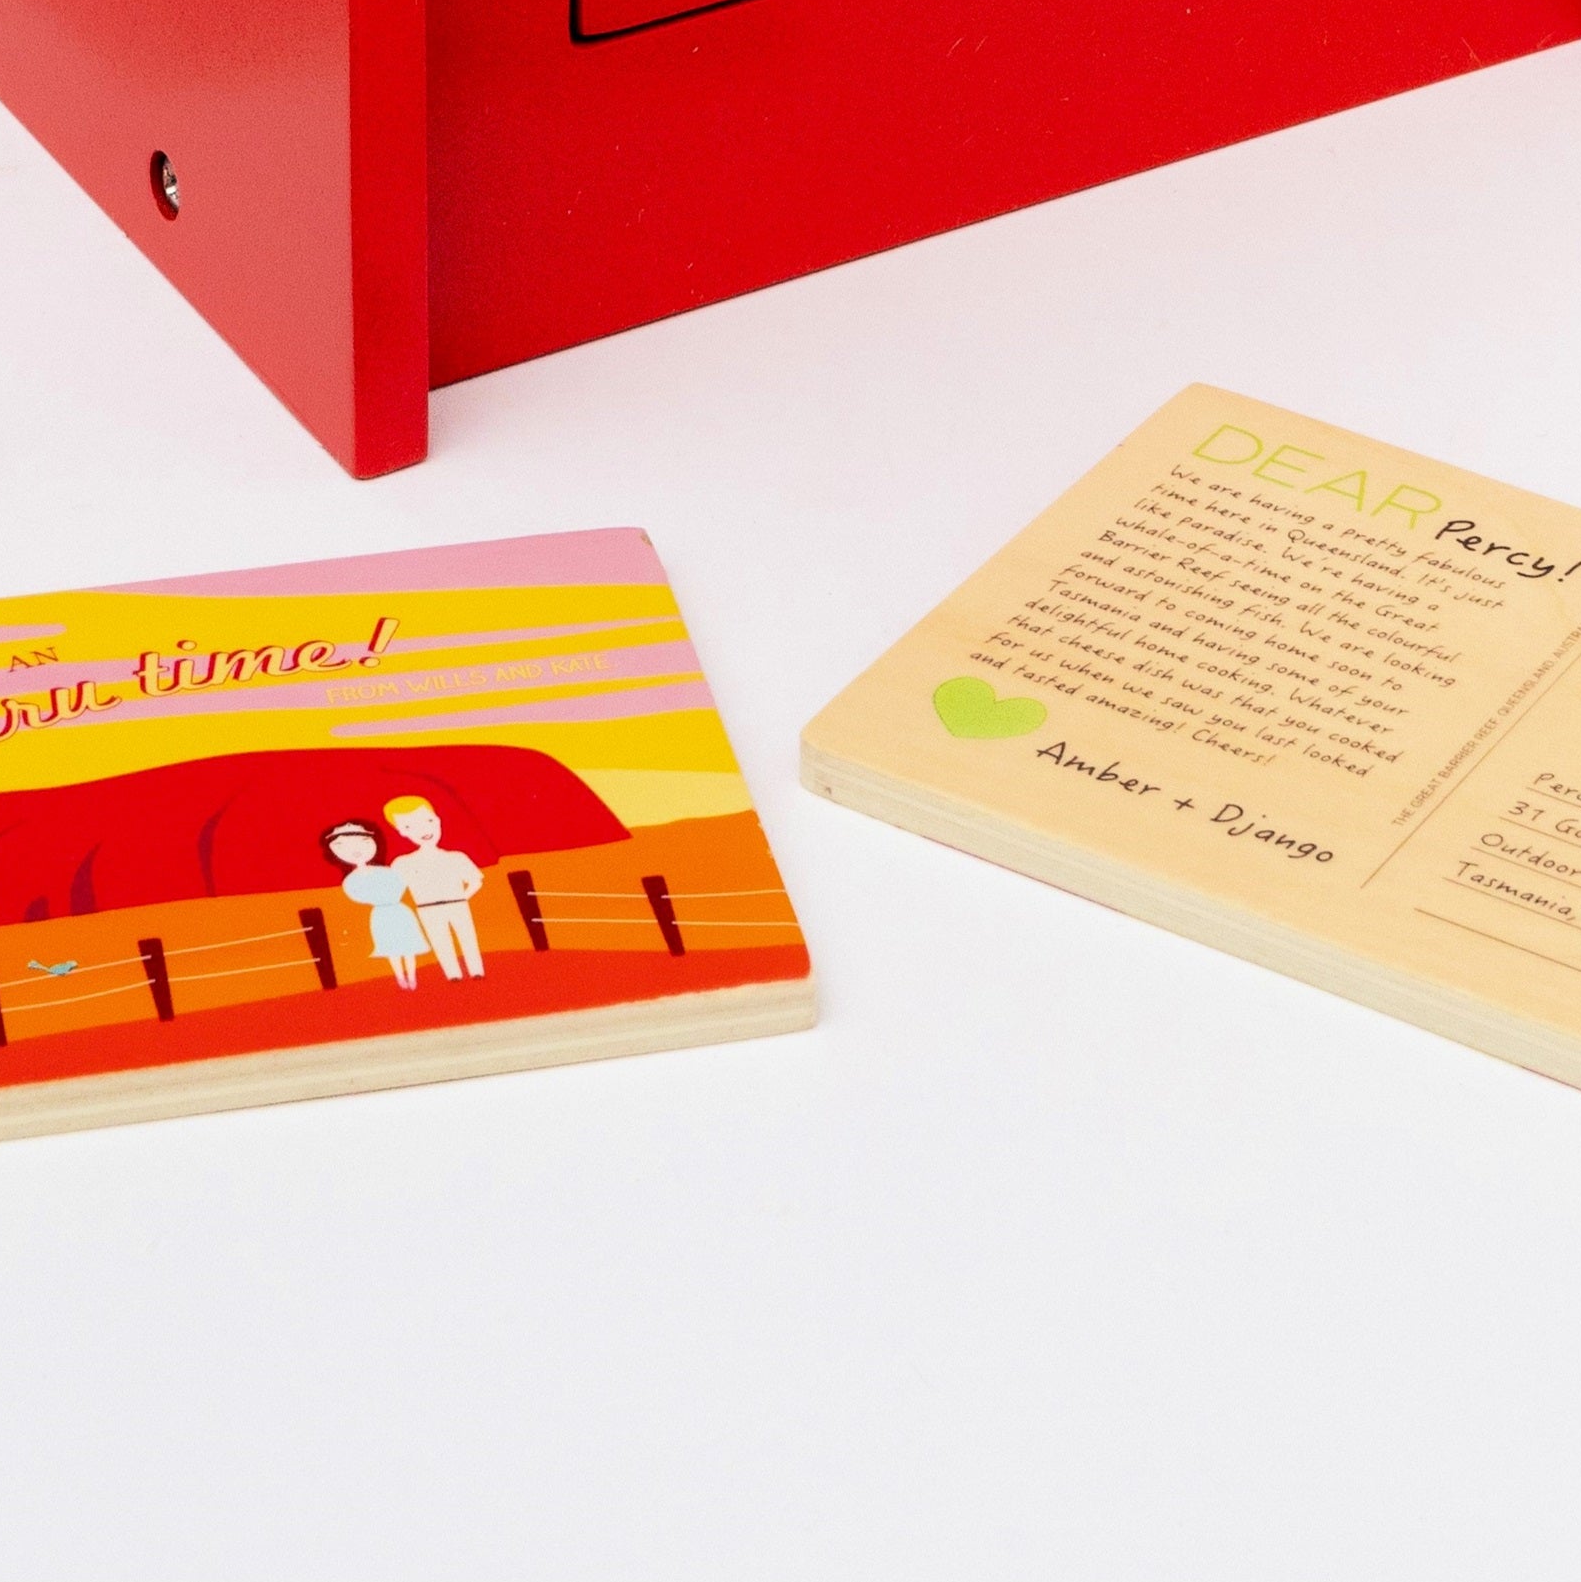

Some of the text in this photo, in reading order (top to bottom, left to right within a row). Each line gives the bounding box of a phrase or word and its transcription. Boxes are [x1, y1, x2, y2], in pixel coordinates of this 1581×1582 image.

[1170, 464, 1507, 589] We are having a pretty fabulous
[1191, 423, 1444, 530] DEAR
[1134, 498, 1439, 613] like paradise. We're having a
[1151, 484, 1505, 612] time here in Queensland. It's just
[8, 647, 60, 673] AN
[132, 617, 400, 697] time!
[1035, 741, 1334, 864] Amber + Django
[1508, 800, 1545, 822] 31
[1457, 860, 1577, 920] Tasmania,
